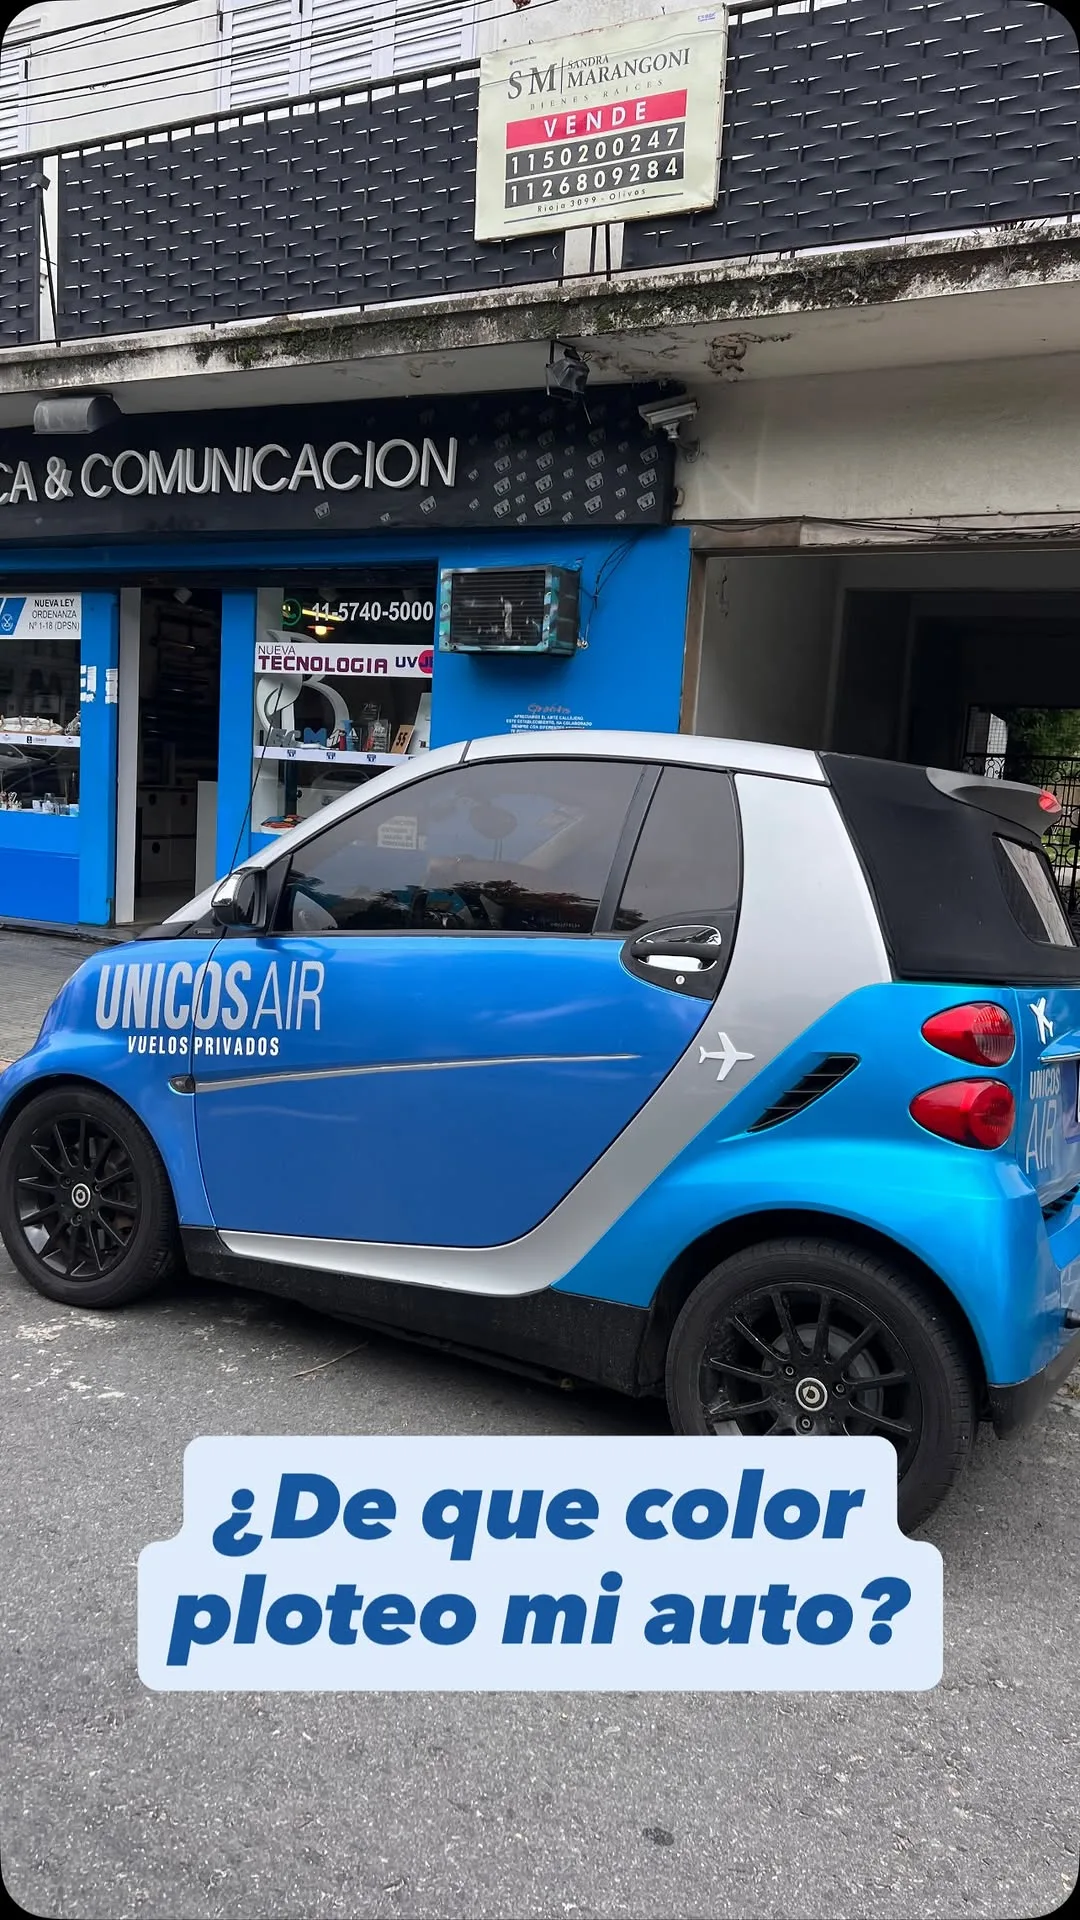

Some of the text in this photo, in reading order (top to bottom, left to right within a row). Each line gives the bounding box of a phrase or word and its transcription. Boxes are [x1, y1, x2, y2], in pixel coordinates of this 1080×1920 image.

[567, 48, 691, 88] MARANGONI
[568, 55, 610, 69] SANDRA
[530, 95, 589, 111] BIENES
[543, 101, 647, 138] VENDE
[511, 128, 679, 174] 1150200247
[511, 157, 678, 203] 1126809284
[537, 203, 566, 213] Rioja
[570, 196, 597, 208] 3099
[609, 188, 647, 201] Olivos
[45, 456, 74, 500] &
[81, 437, 458, 498] COMUNICACION
[32, 610, 77, 619] ORDENANZA
[34, 598, 75, 608] NUEVA LEY
[312, 601, 433, 622] 11-5740-5000
[55, 621, 80, 632] (DPSN)
[258, 645, 296, 655] NUEVA
[258, 655, 388, 674] TECNOLOGIA
[96, 960, 325, 1031] UNICOS AIR
[127, 1035, 279, 1056] VUELOS PRIVADOS
[1030, 1067, 1061, 1100] UNICOS
[1026, 1100, 1057, 1174] AIR
